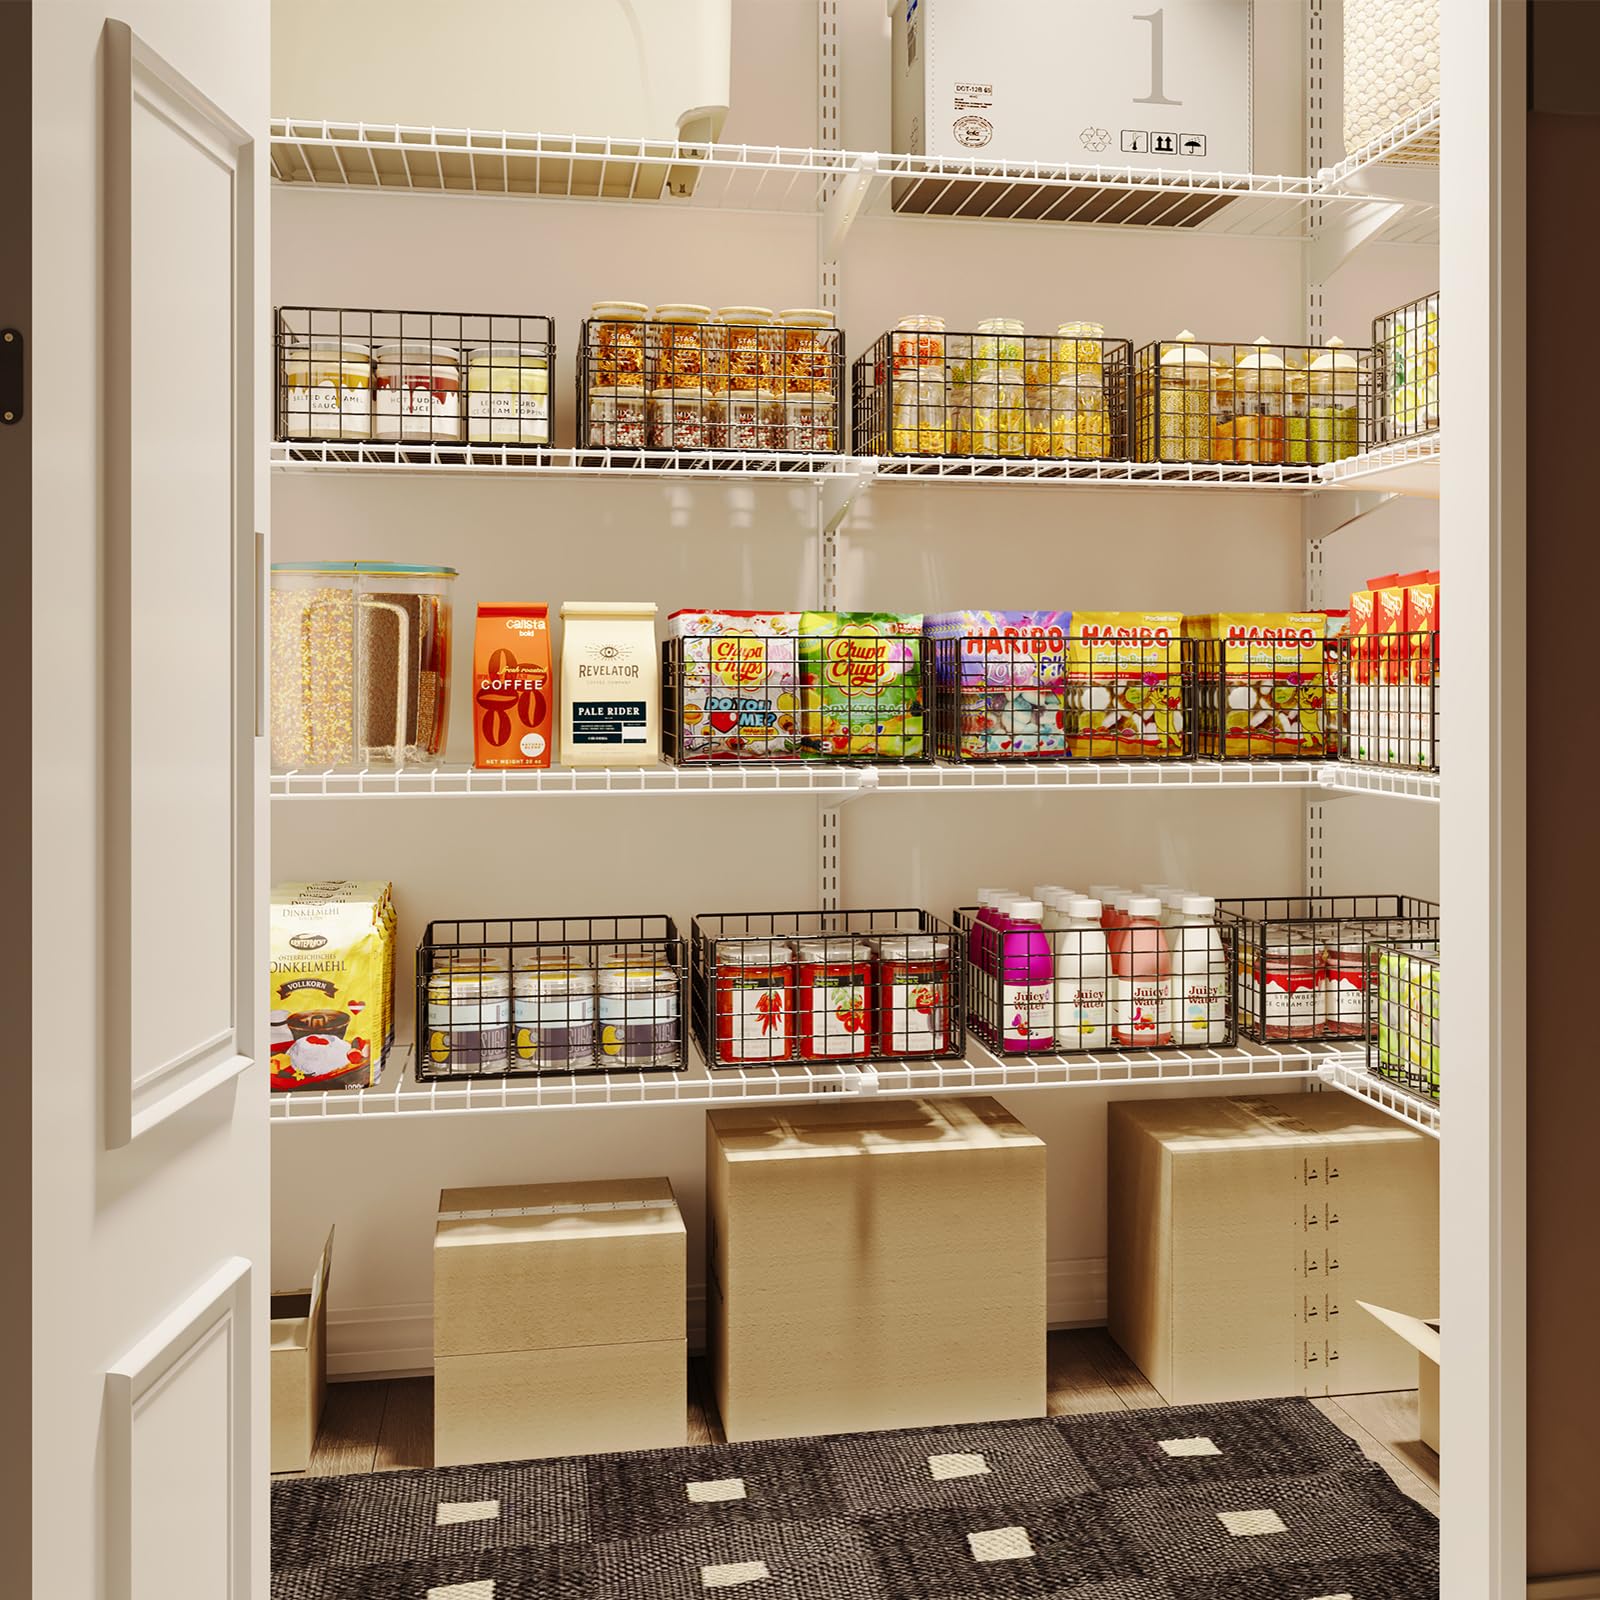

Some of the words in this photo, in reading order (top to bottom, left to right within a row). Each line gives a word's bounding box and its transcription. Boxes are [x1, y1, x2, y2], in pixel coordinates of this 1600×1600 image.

[1132, 8, 1183, 106] 1
[966, 626, 1064, 655] HARIBO
[1081, 625, 1169, 647] HARIBO
[1229, 625, 1314, 648] HARIBO
[836, 641, 886, 660] Chupa
[578, 664, 640, 679] REVELATOR
[832, 659, 885, 686] Chups
[481, 679, 543, 690] COFFEE
[578, 707, 604, 716] PALE
[607, 706, 640, 716] RIDER
[288, 980, 327, 990] VOLLKORN
[1074, 990, 1105, 999] Juicy
[1134, 988, 1163, 997] Juicy
[1188, 986, 1218, 995] Juicy
[1014, 992, 1044, 1001] Juicy
[1133, 997, 1164, 1006] Water
[1187, 995, 1218, 1004] Water
[1013, 1001, 1045, 1011] Water
[1072, 999, 1105, 1008] Water
